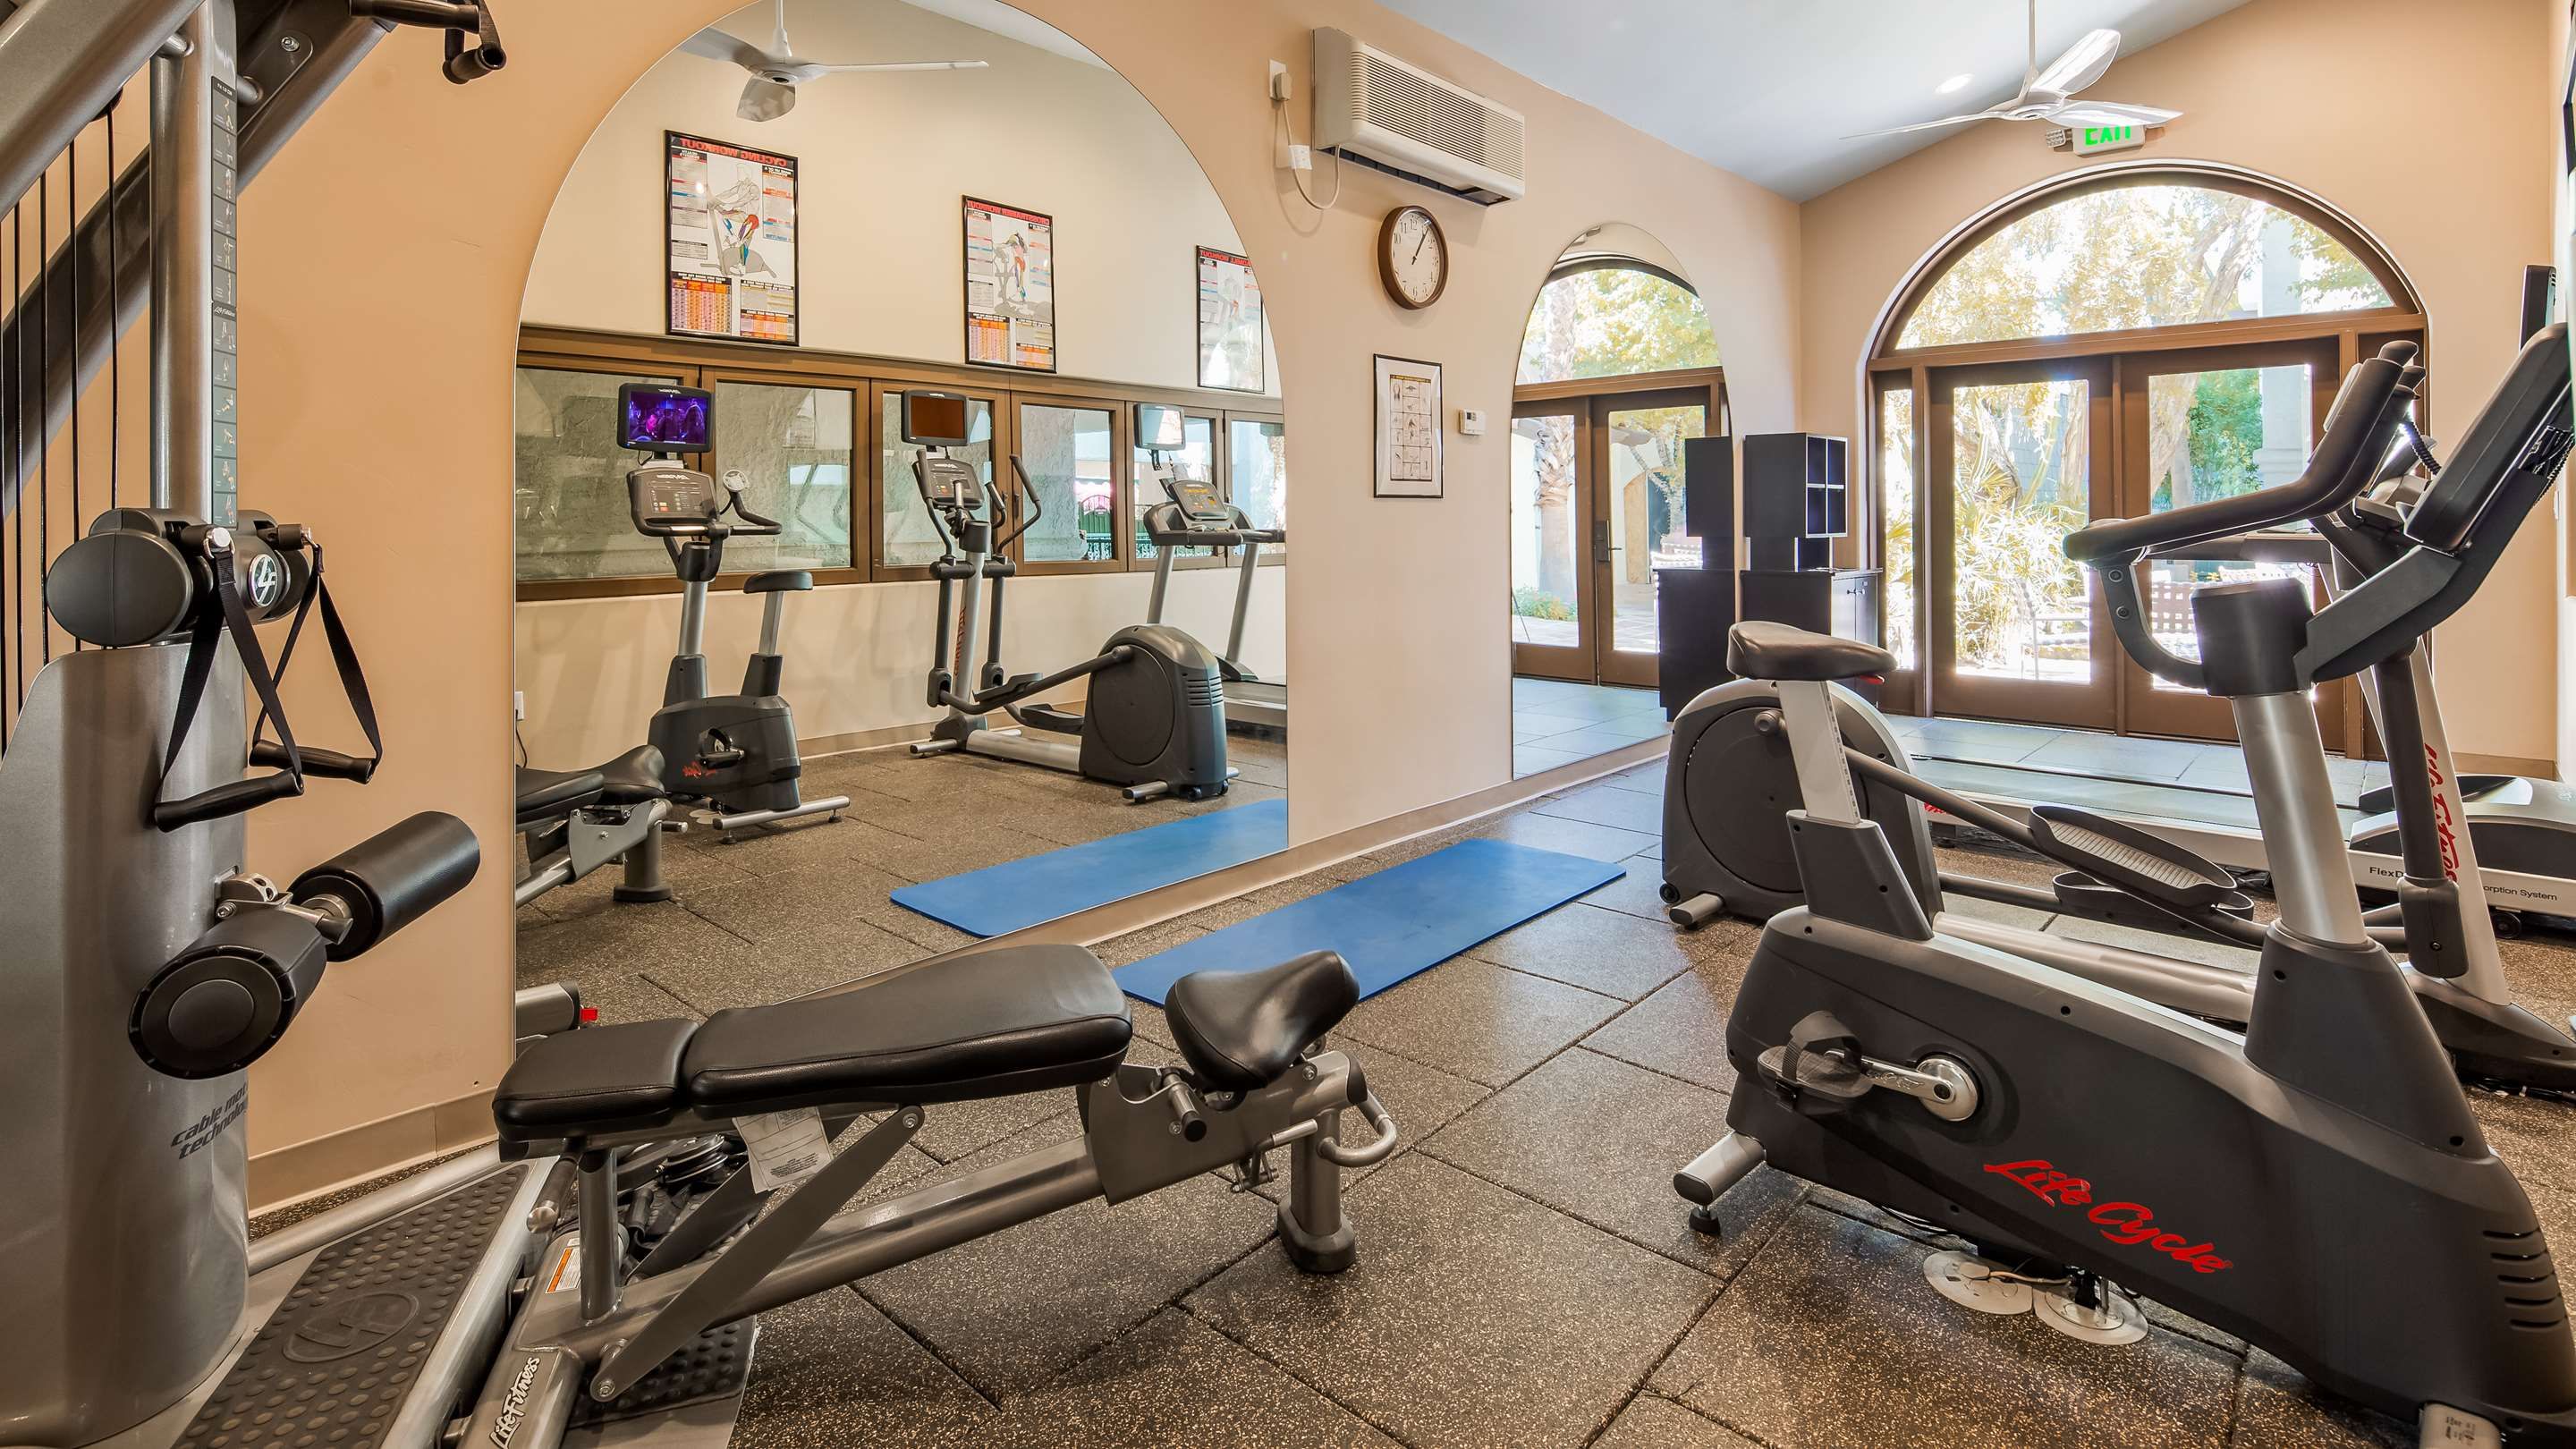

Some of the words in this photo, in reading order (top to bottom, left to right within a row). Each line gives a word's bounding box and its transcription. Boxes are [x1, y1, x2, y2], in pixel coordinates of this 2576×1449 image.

[2369, 866, 2404, 878] FlexD
[2483, 885, 2518, 895] orption
[2520, 888, 2558, 901] System
[171, 1106, 223, 1148] cable
[225, 1080, 249, 1112] mot
[178, 1101, 248, 1160] technolo
[1982, 1159, 2092, 1208] Life
[2088, 1201, 2233, 1274] Cycle
